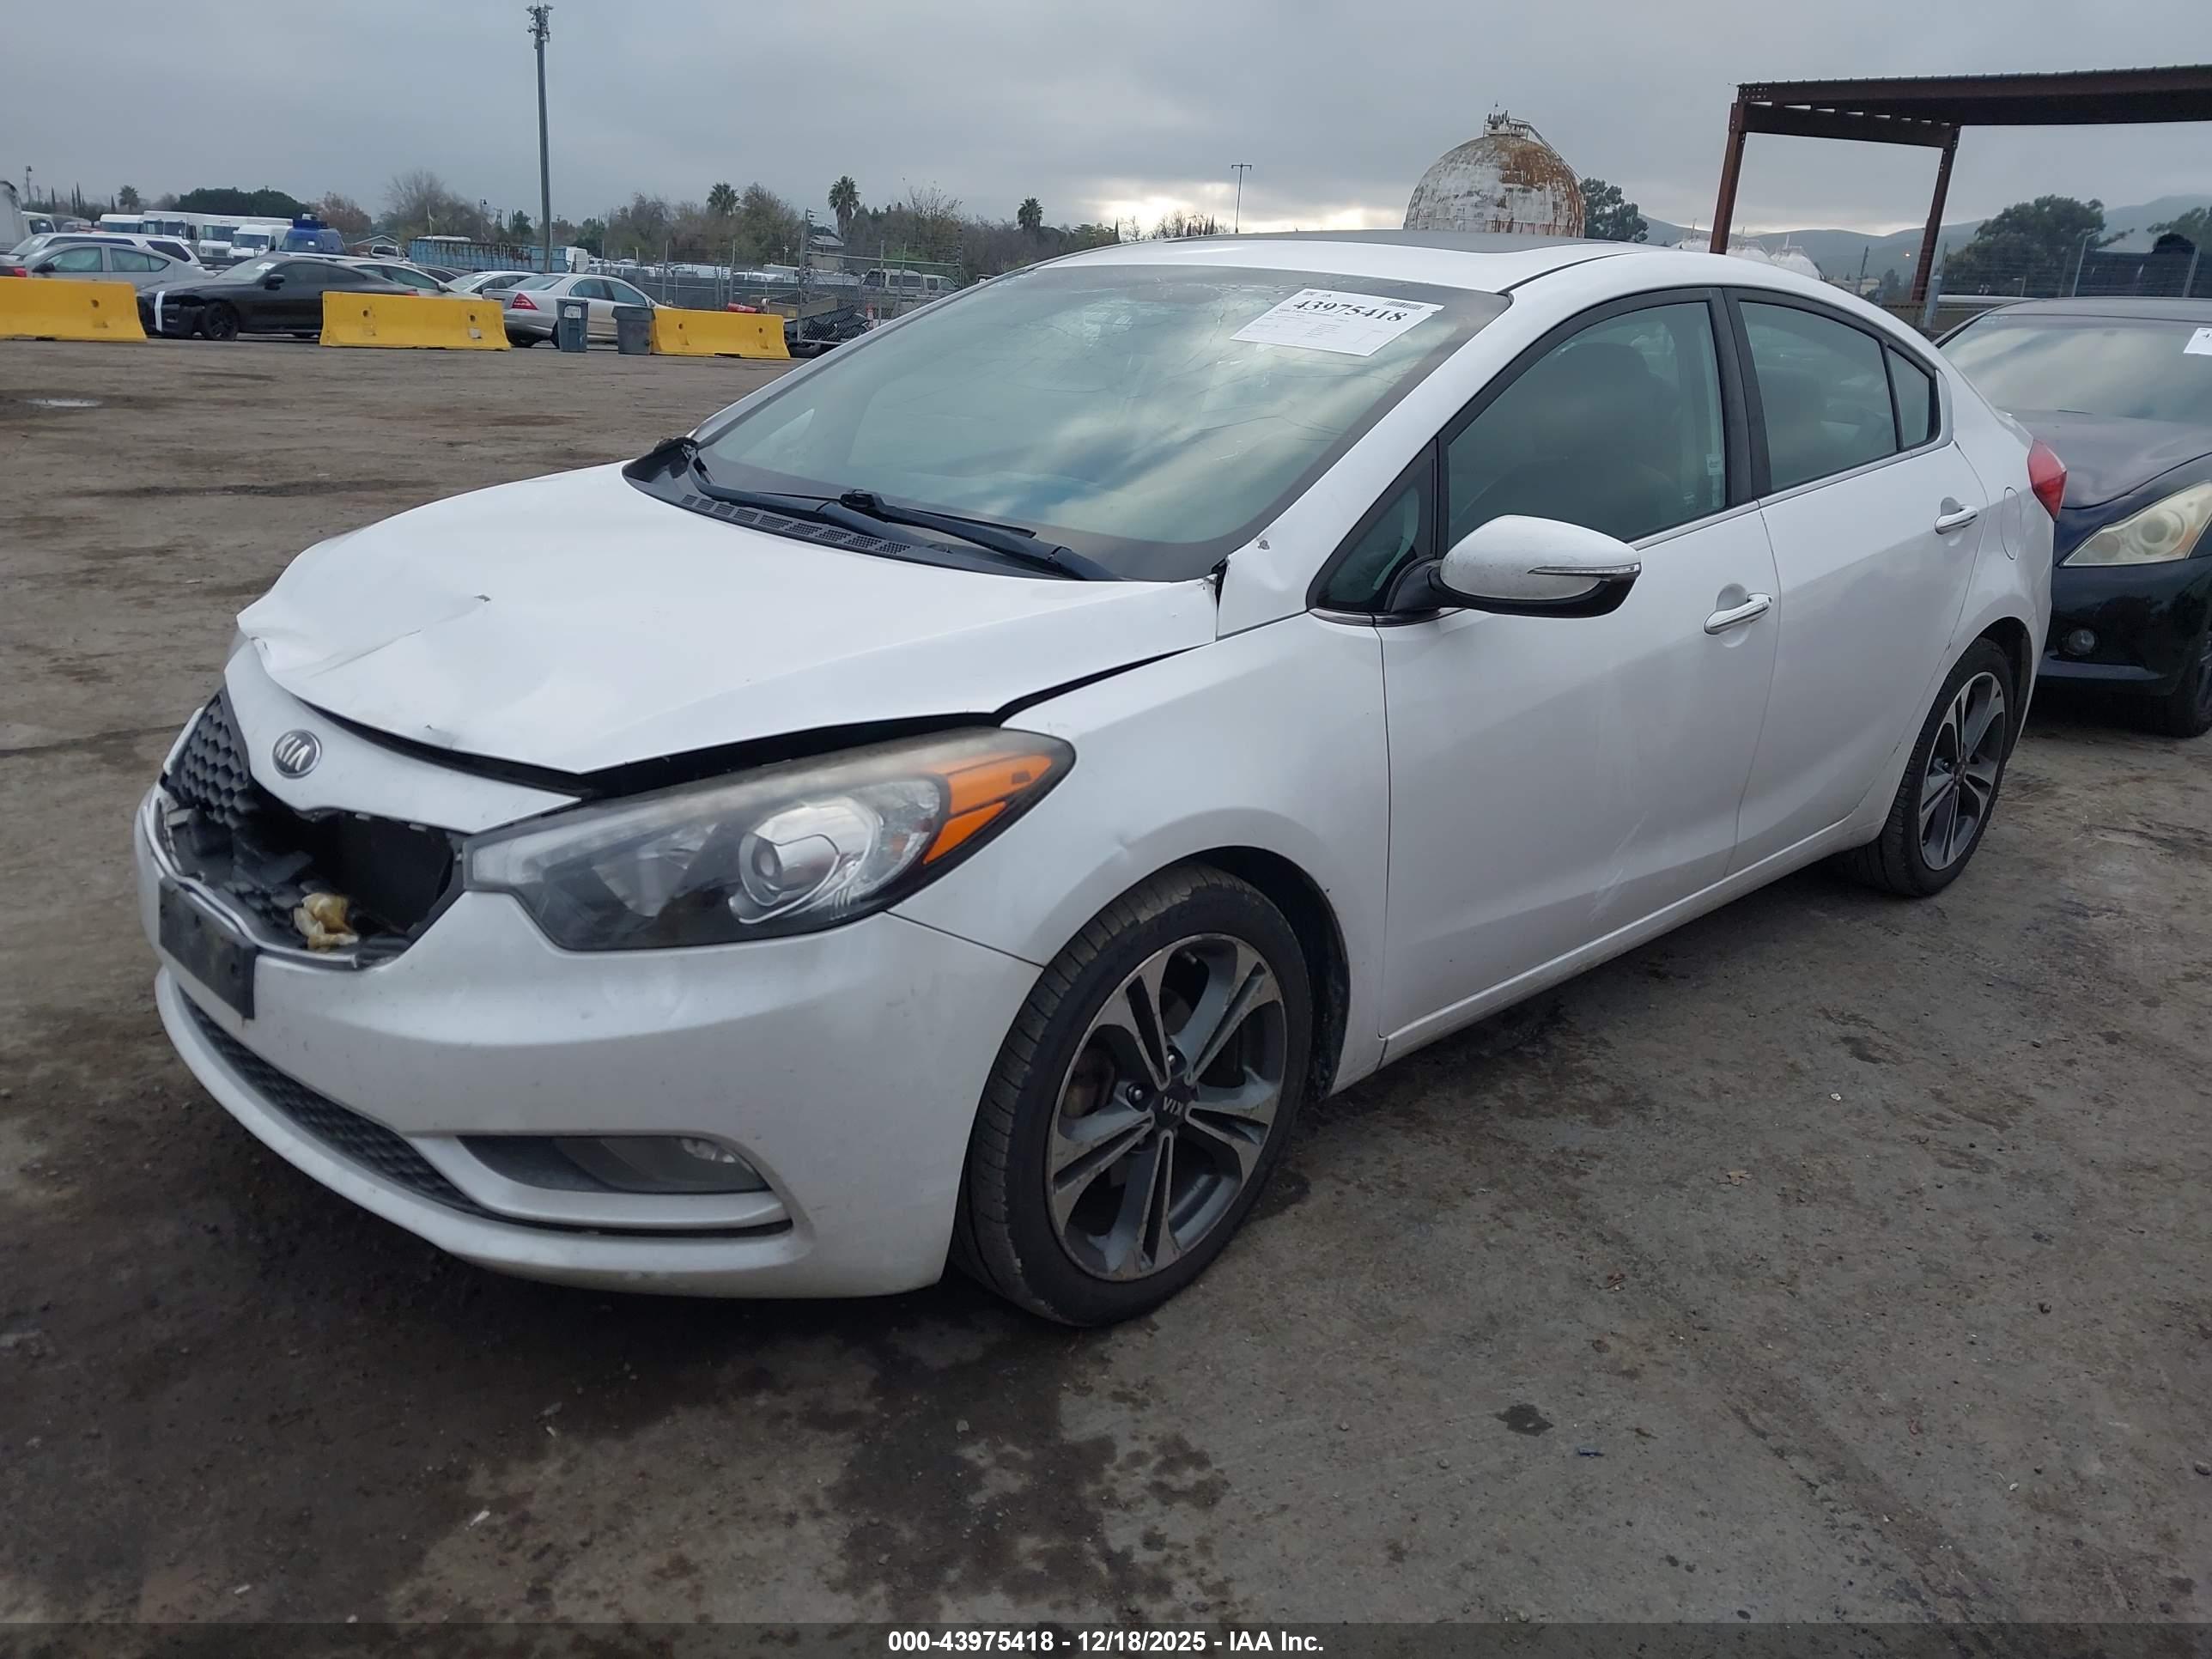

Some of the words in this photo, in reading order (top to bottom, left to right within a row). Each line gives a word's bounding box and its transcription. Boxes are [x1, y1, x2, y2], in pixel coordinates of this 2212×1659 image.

[1292, 300, 1409, 323] 43975418
[274, 732, 311, 772] KIA
[1163, 1095, 1184, 1117] KIA
